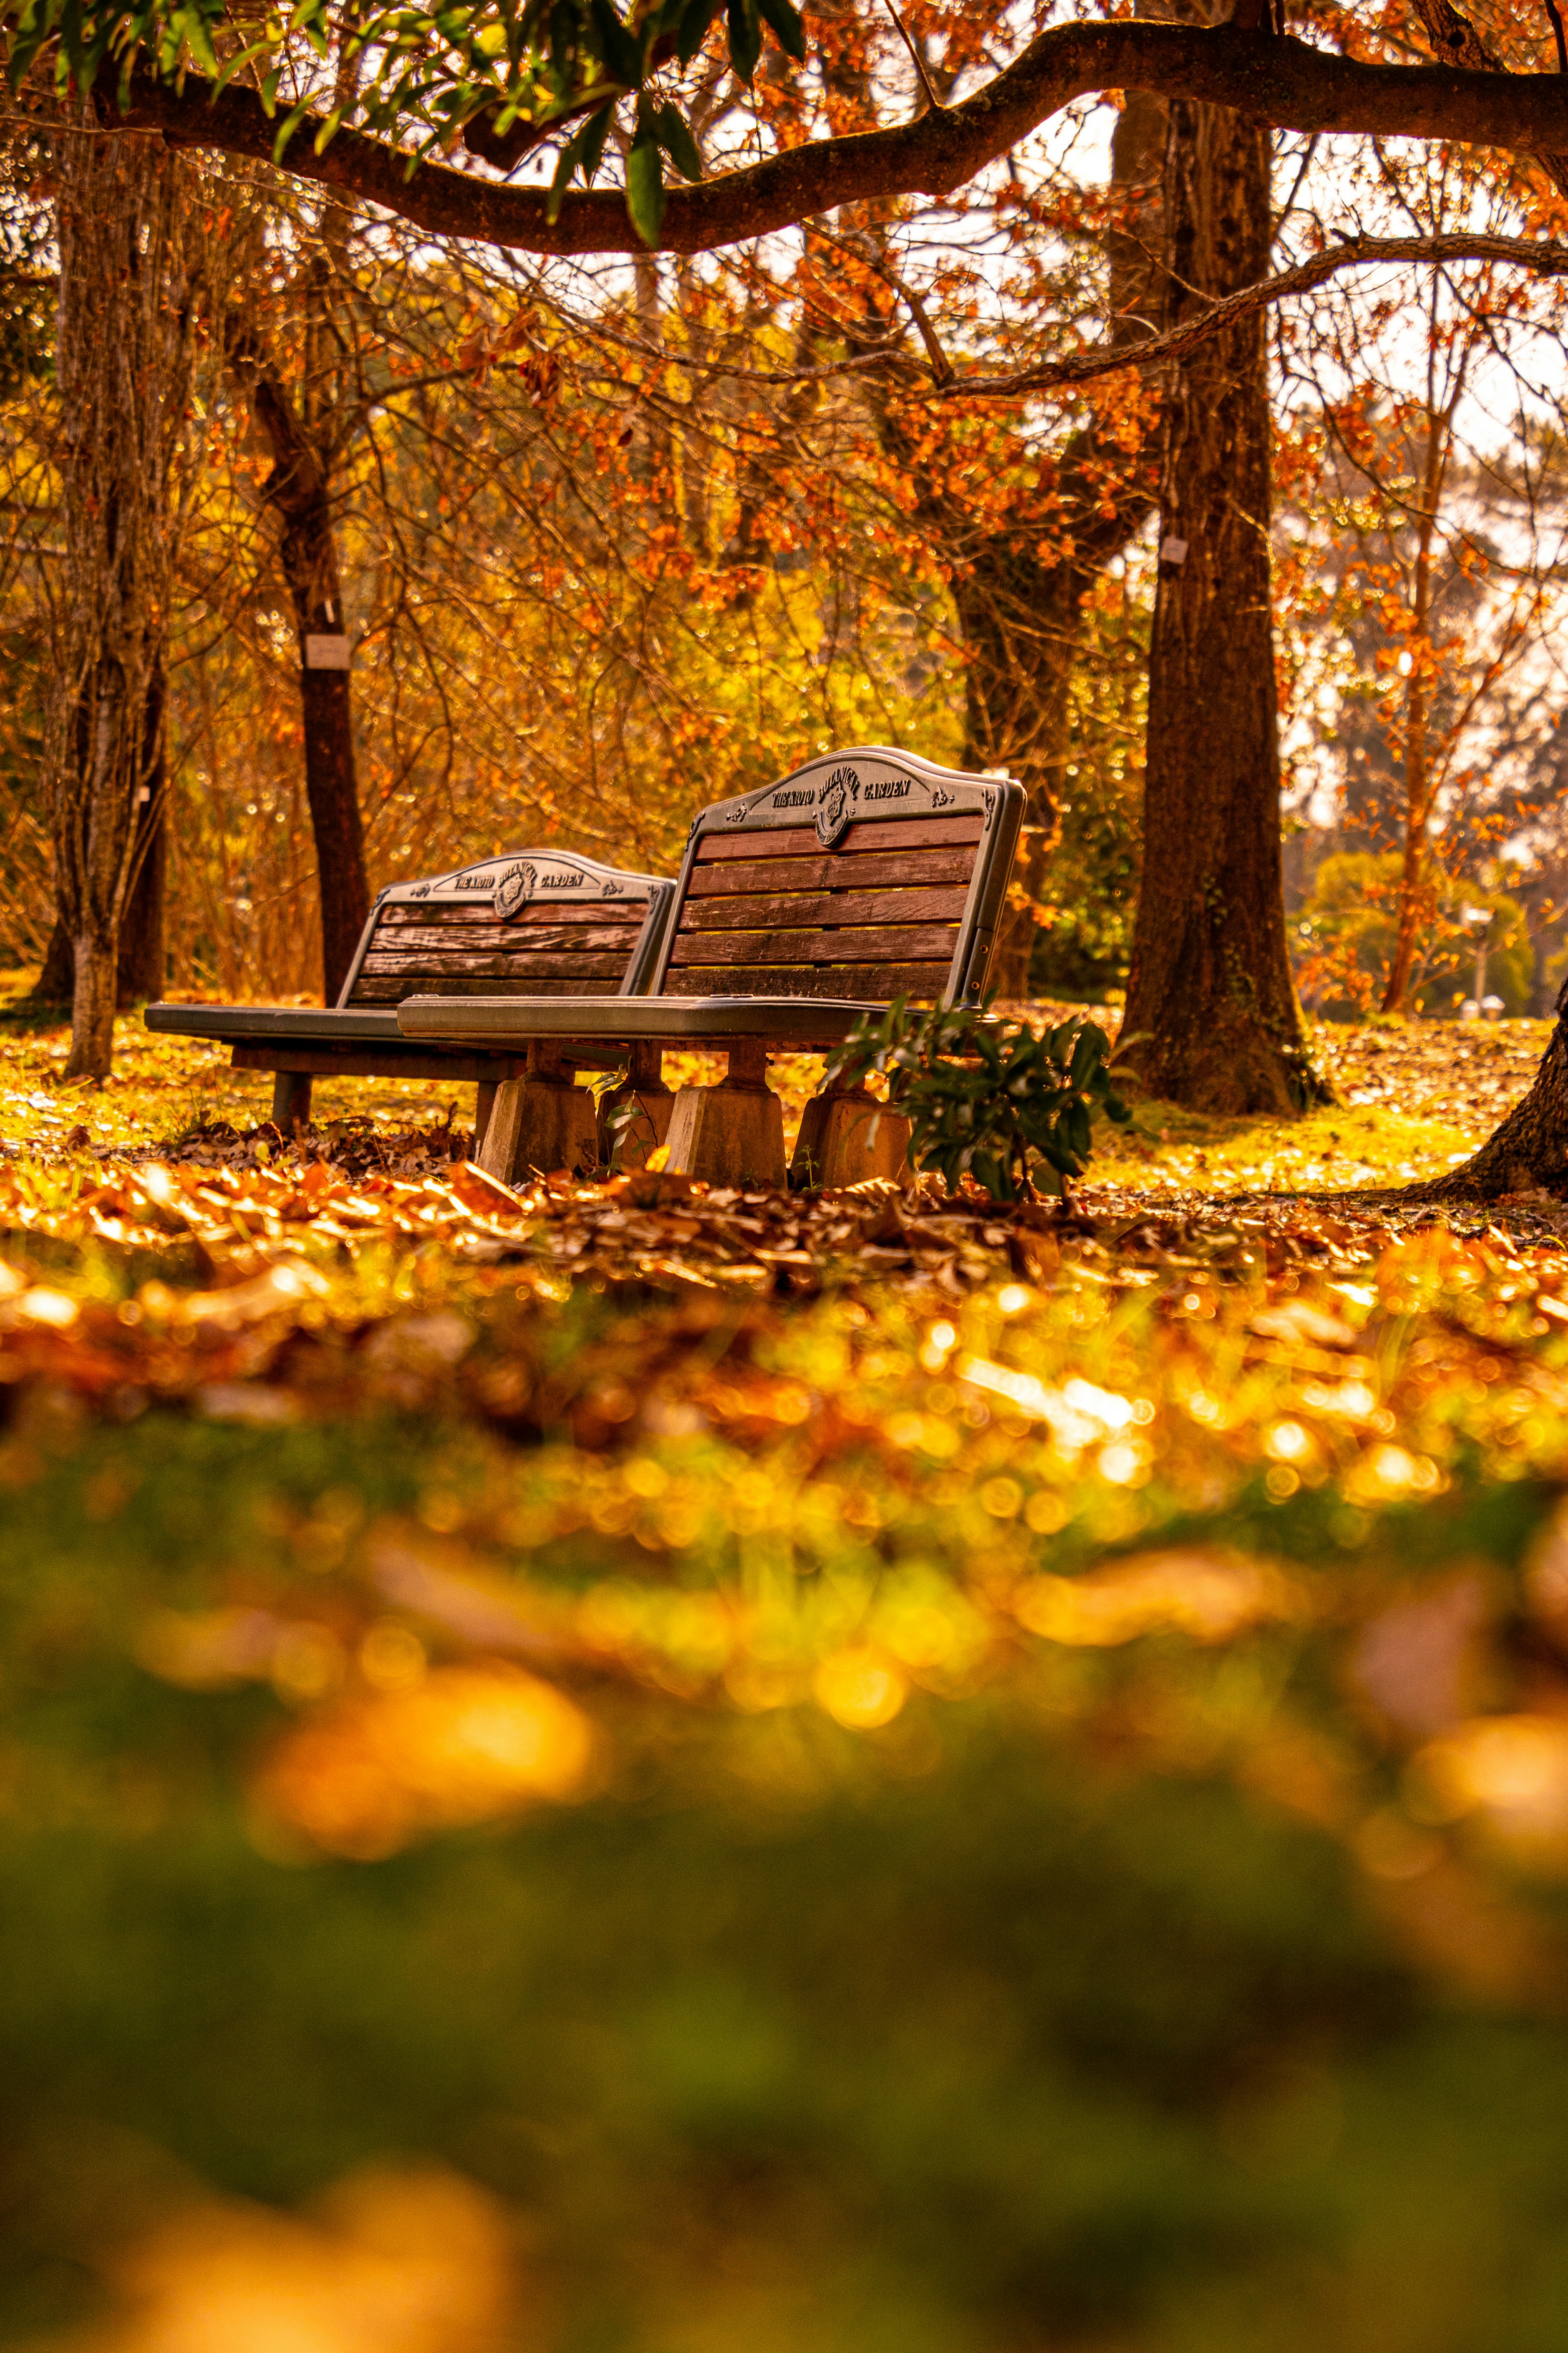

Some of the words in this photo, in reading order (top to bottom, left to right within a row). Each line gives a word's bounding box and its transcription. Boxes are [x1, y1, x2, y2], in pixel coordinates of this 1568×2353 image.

[772, 792, 789, 807] THE
[788, 789, 814, 805] KYOTO
[819, 766, 859, 803] BOTANICAL
[863, 779, 911, 799] GARDEN
[455, 877, 471, 888] THE
[470, 876, 495, 888] KYOTO
[499, 862, 537, 888] BOTANICAL
[541, 875, 584, 887] GARDEN
